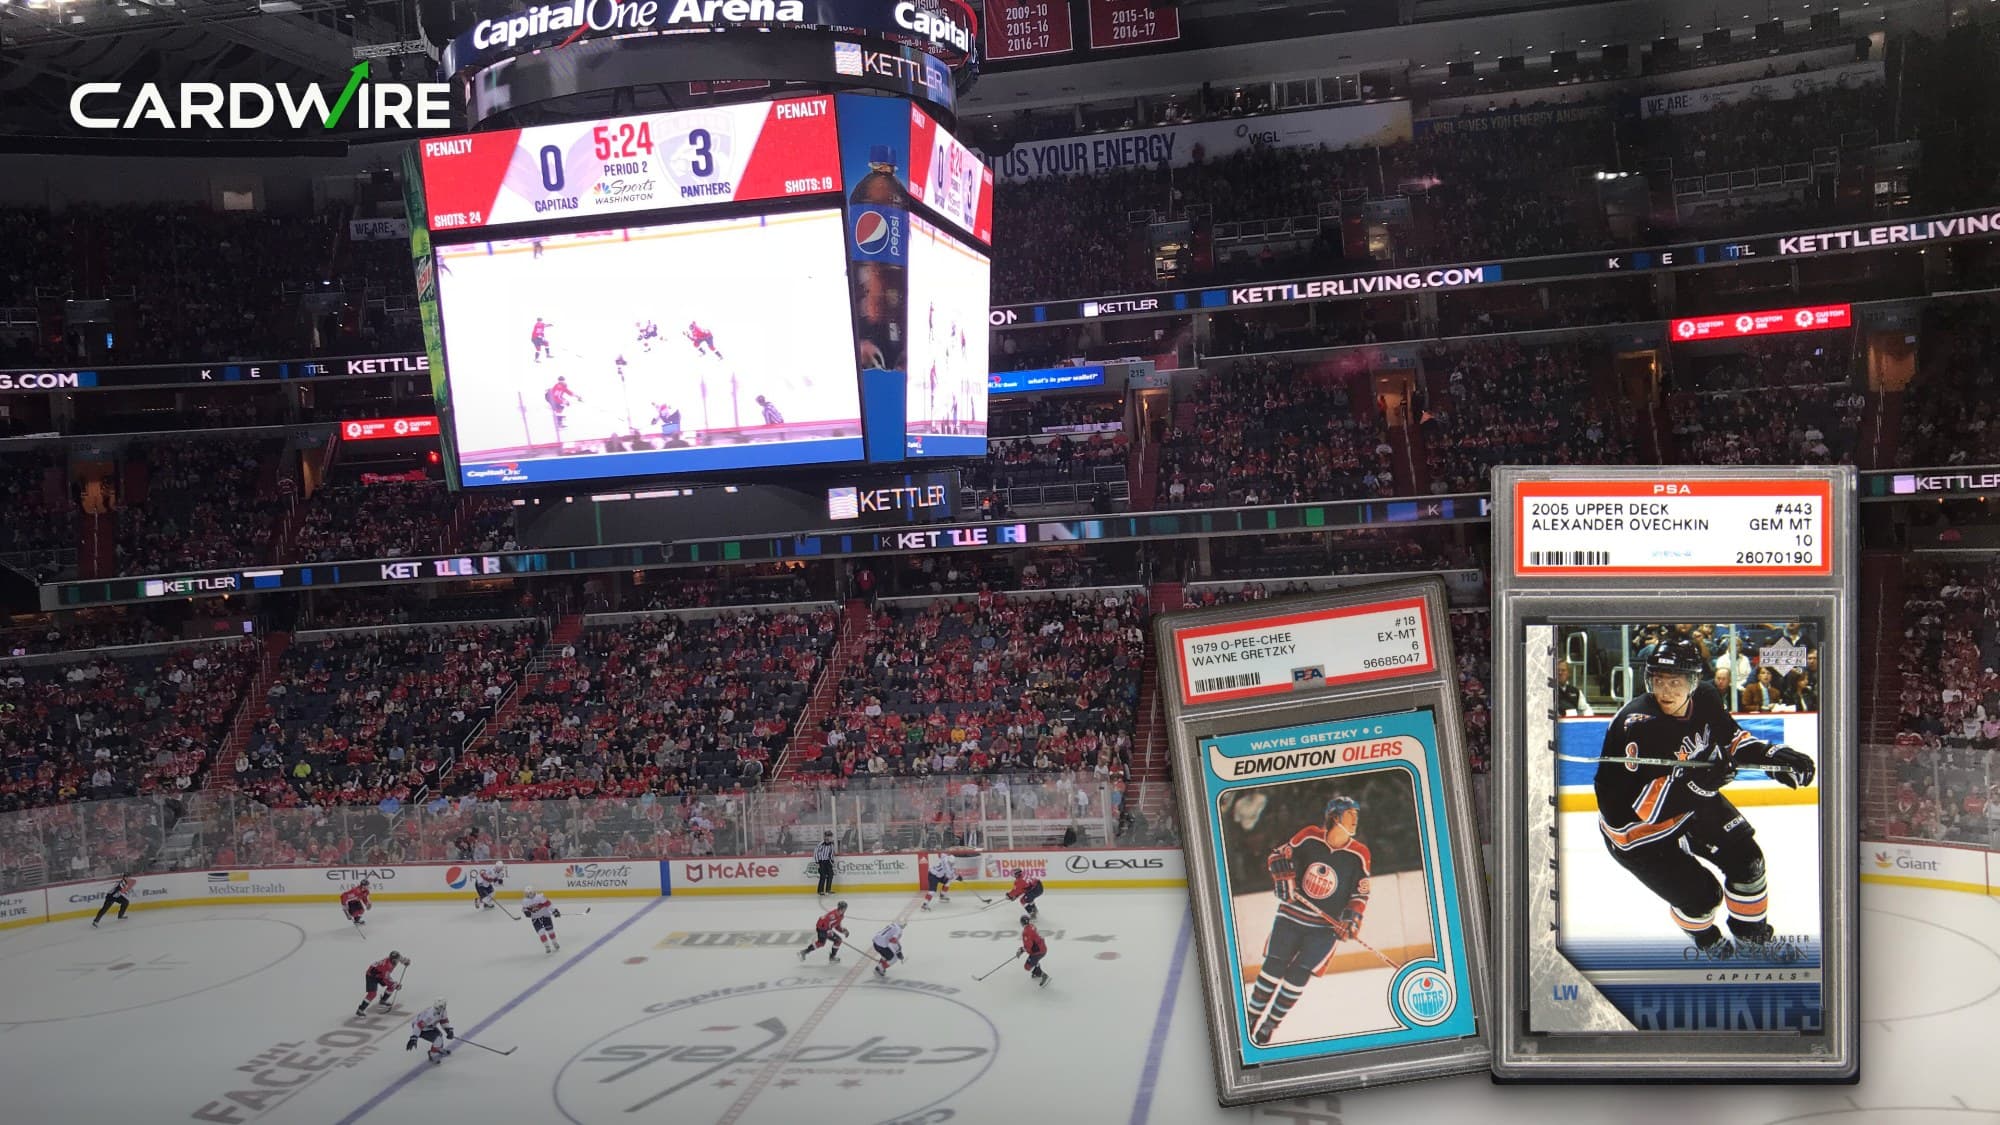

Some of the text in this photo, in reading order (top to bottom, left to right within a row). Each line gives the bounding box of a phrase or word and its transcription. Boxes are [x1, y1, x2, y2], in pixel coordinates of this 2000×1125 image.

[1006, 3, 1048, 20] 2009-10
[473, 0, 804, 50] Capital One Arena
[895, 1, 969, 52] Capital
[1007, 19, 1049, 36] 2015-16
[1113, 22, 1156, 40] 2016-17
[1007, 34, 1050, 52] 2016-17
[864, 50, 943, 93] KETTLER
[777, 99, 827, 120] PENALTY
[593, 121, 655, 161] 5:24
[1248, 131, 1281, 145] WGL
[425, 139, 473, 158] PENALTY
[688, 128, 714, 178] 3
[1002, 148, 1028, 178] US
[1032, 142, 1089, 175] YOUR
[1093, 132, 1177, 168] ENERGY
[540, 144, 565, 192] 0
[604, 160, 648, 177] PERIOD 2
[610, 179, 657, 197] Sports
[680, 181, 732, 198] PANTHERS
[785, 176, 833, 194] SHOTS: 19
[534, 196, 579, 213] CAPITALS
[594, 192, 654, 206] WASHINGTON
[434, 211, 482, 228] SHOTS: 24
[890, 215, 901, 257] pepsi
[1232, 266, 1484, 305] KETTLERLIVING.COM
[1098, 299, 1158, 315] KETTLER
[347, 355, 430, 374] KETTLE
[1130, 369, 1145, 378] 215
[1653, 484, 1691, 494] PSA
[860, 484, 946, 513] KETTLER
[1531, 503, 1669, 516] 2005 UPPER DECK
[1775, 503, 1813, 516] #443
[1531, 518, 1710, 532] ALEXANDER OVECHKIN
[1749, 518, 1813, 531] GEM MT
[1796, 534, 1813, 547] 10
[1735, 552, 1813, 565] 26070190
[164, 577, 236, 593] KETTLER
[1192, 632, 1292, 655] 1979 O-PEE-CHEE
[1377, 628, 1417, 643] EX-MT
[1411, 641, 1419, 651] 6
[1192, 643, 1297, 667] WAYNE GRETZKY
[1363, 652, 1420, 670] 96685047
[1294, 667, 1323, 682] PSA
[1251, 726, 1383, 751] WAYNE GRETZKY C
[1233, 741, 1404, 776] EDMONTON OILERS
[584, 863, 632, 879] Sports
[708, 861, 780, 879] McAfee
[1002, 859, 1049, 868] DUNKIN'
[1092, 858, 1163, 869] LEXUS
[1896, 856, 1938, 872] Giant
[326, 868, 396, 880] ETIHAD
[470, 866, 509, 882] psi
[208, 883, 285, 895] MedStar Health
[567, 879, 628, 888] WASHINGTON
[69, 892, 109, 903] Capit
[142, 888, 168, 897] Bank
[949, 929, 1067, 941] ledos
[1706, 973, 1798, 981] CAPITALS
[1553, 983, 1579, 1001] LW
[1633, 986, 1822, 1031] ROOKIES
[235, 1040, 306, 1073] NHL
